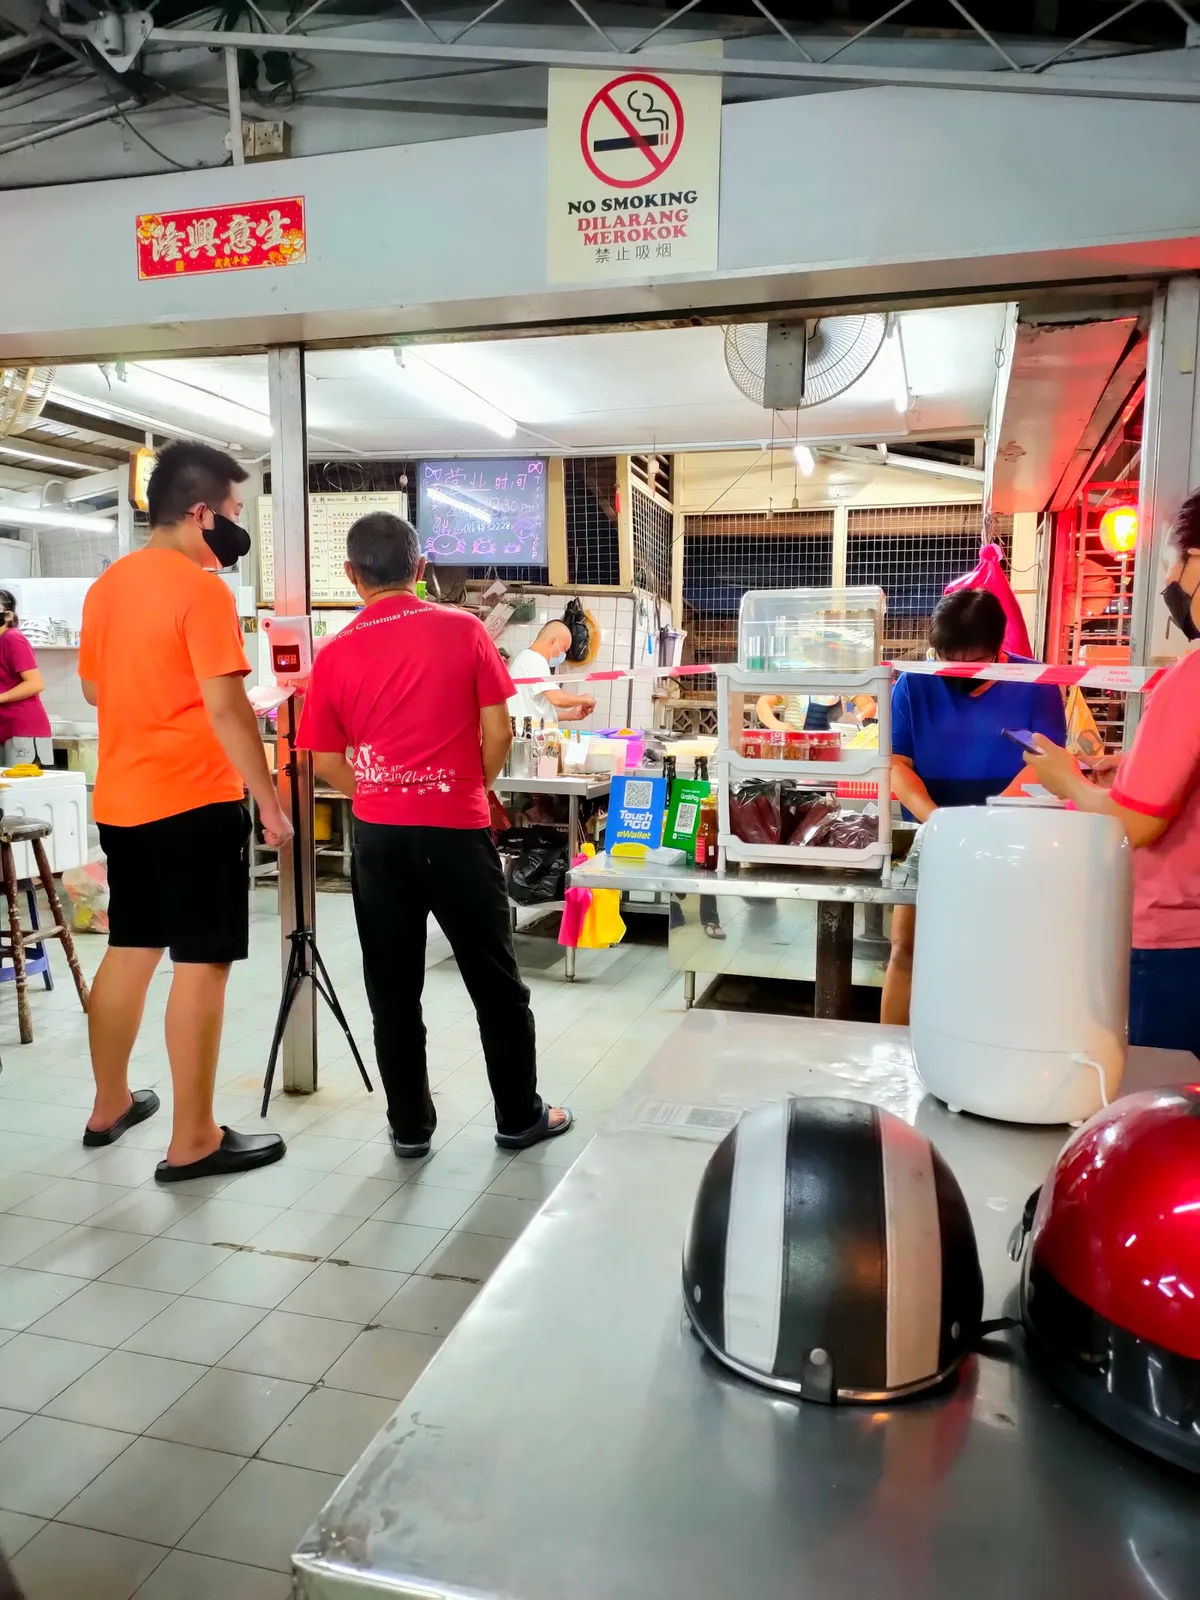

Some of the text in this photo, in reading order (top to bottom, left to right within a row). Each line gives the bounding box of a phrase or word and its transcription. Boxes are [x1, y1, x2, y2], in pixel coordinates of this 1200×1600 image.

[568, 190, 698, 214] NO SMOKING
[577, 208, 689, 232] DILARANG
[583, 224, 688, 246] MEROKOK
[595, 243, 672, 264] 禁止吸烟
[355, 613, 401, 630] Christmas
[402, 606, 434, 617] Parade
[680, 793, 700, 803] GrabPay
[619, 810, 653, 821] Touch
[616, 830, 651, 840] eWallet
